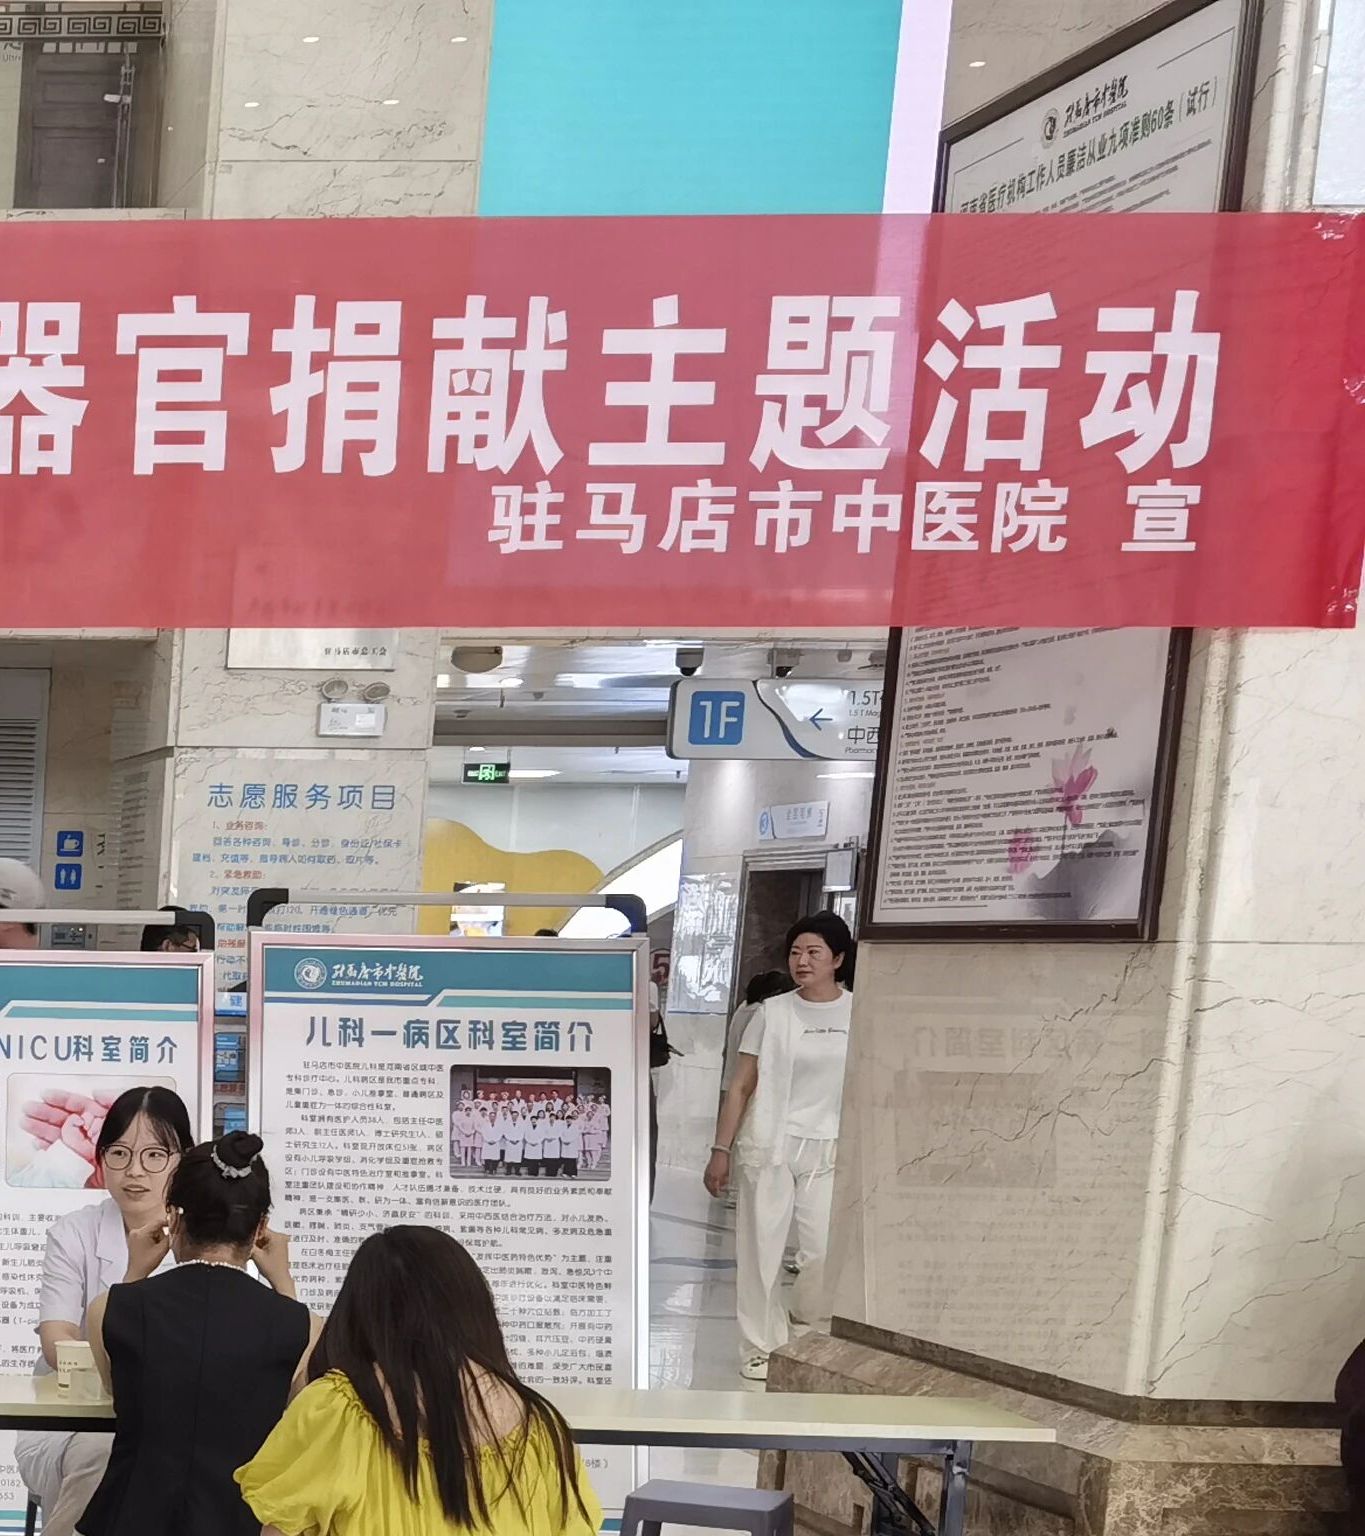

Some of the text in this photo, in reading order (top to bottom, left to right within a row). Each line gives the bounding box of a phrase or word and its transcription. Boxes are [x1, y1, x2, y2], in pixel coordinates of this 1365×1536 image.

[487, 478, 1201, 555] 驻马店市中医院 宣
[849, 690, 884, 706] 1.5T
[698, 699, 741, 740] 1F
[206, 783, 396, 810] 志愿服务项目
[305, 1015, 594, 1053] 儿科一病区科室简介
